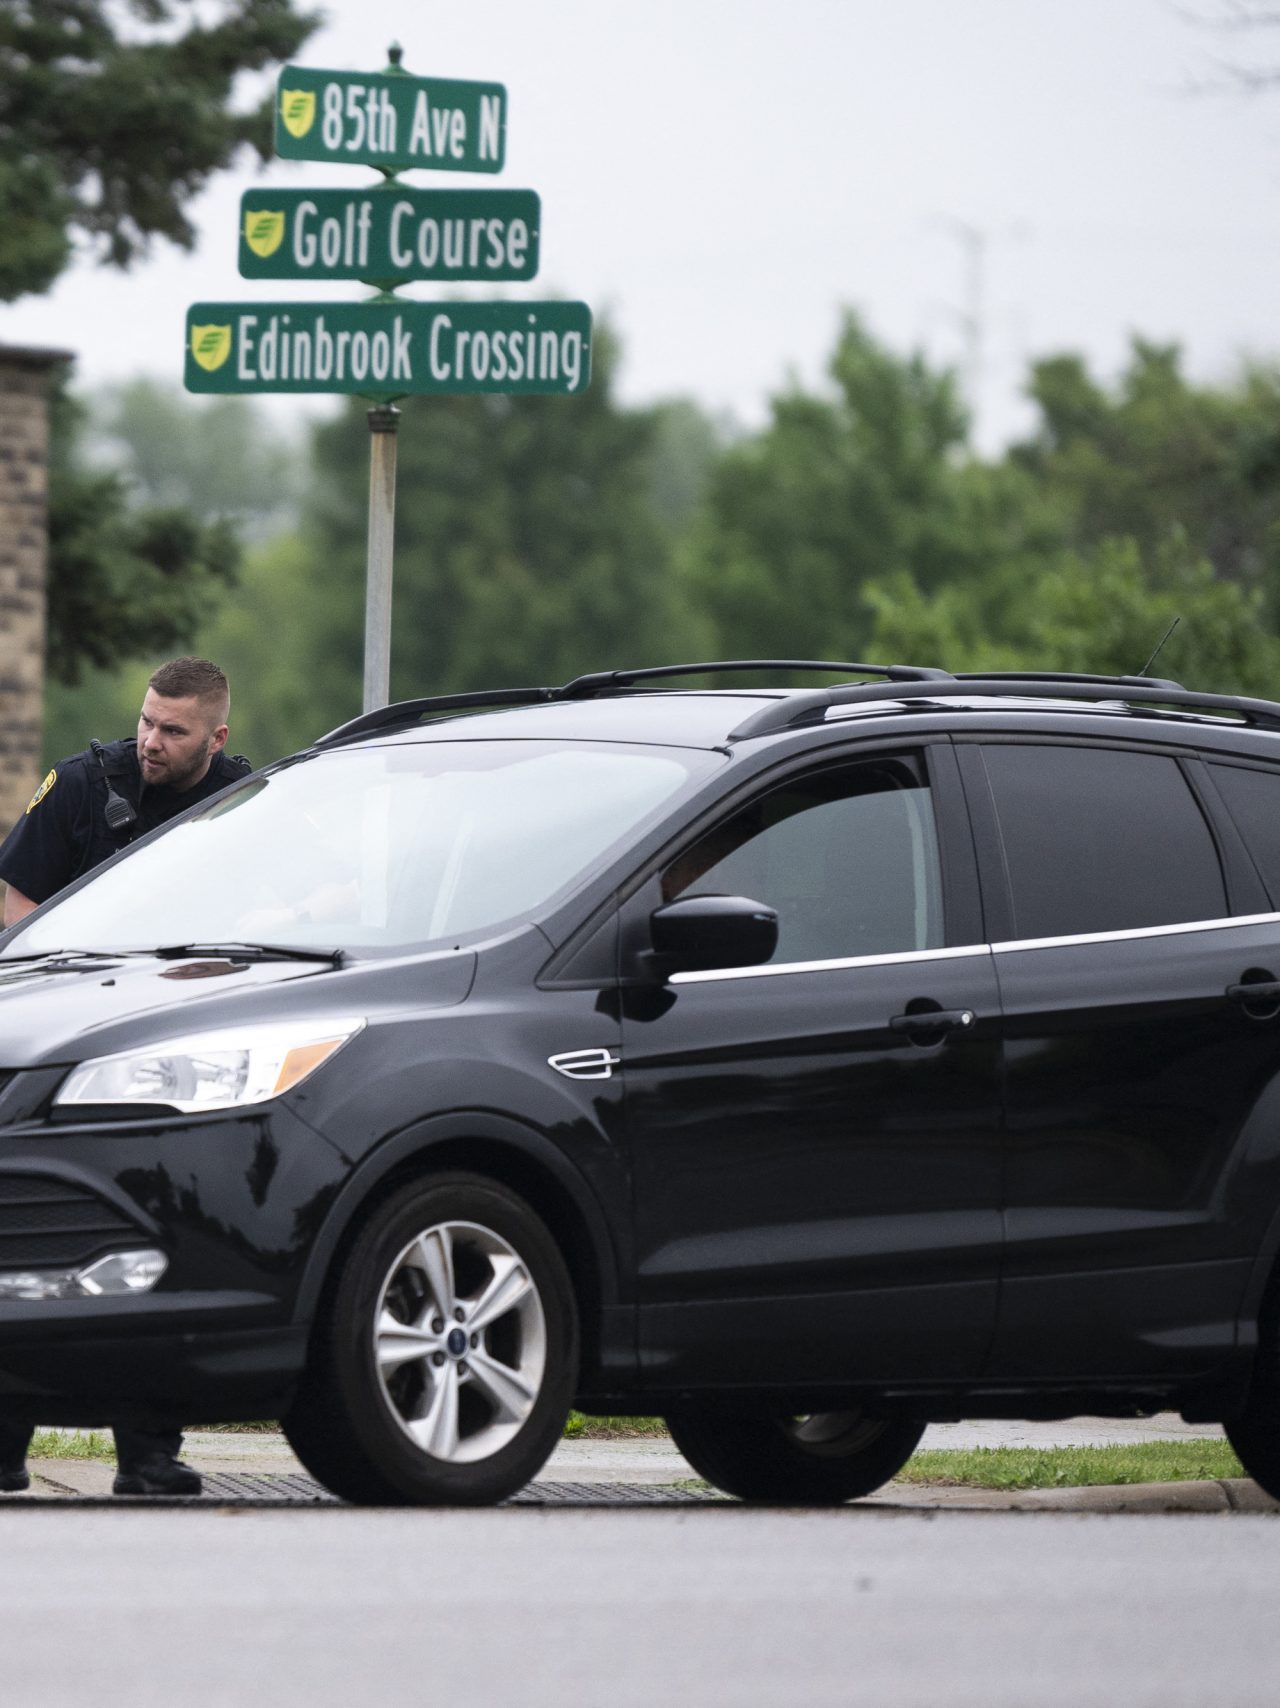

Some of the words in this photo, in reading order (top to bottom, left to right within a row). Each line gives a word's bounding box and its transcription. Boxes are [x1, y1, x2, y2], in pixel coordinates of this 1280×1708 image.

[322, 82, 397, 154] 85th
[409, 90, 466, 159] Ave
[478, 95, 501, 161] N
[293, 200, 373, 268] Golf
[389, 200, 529, 269] Course
[237, 314, 413, 381] Edinbrook
[429, 313, 582, 391] Crossing
